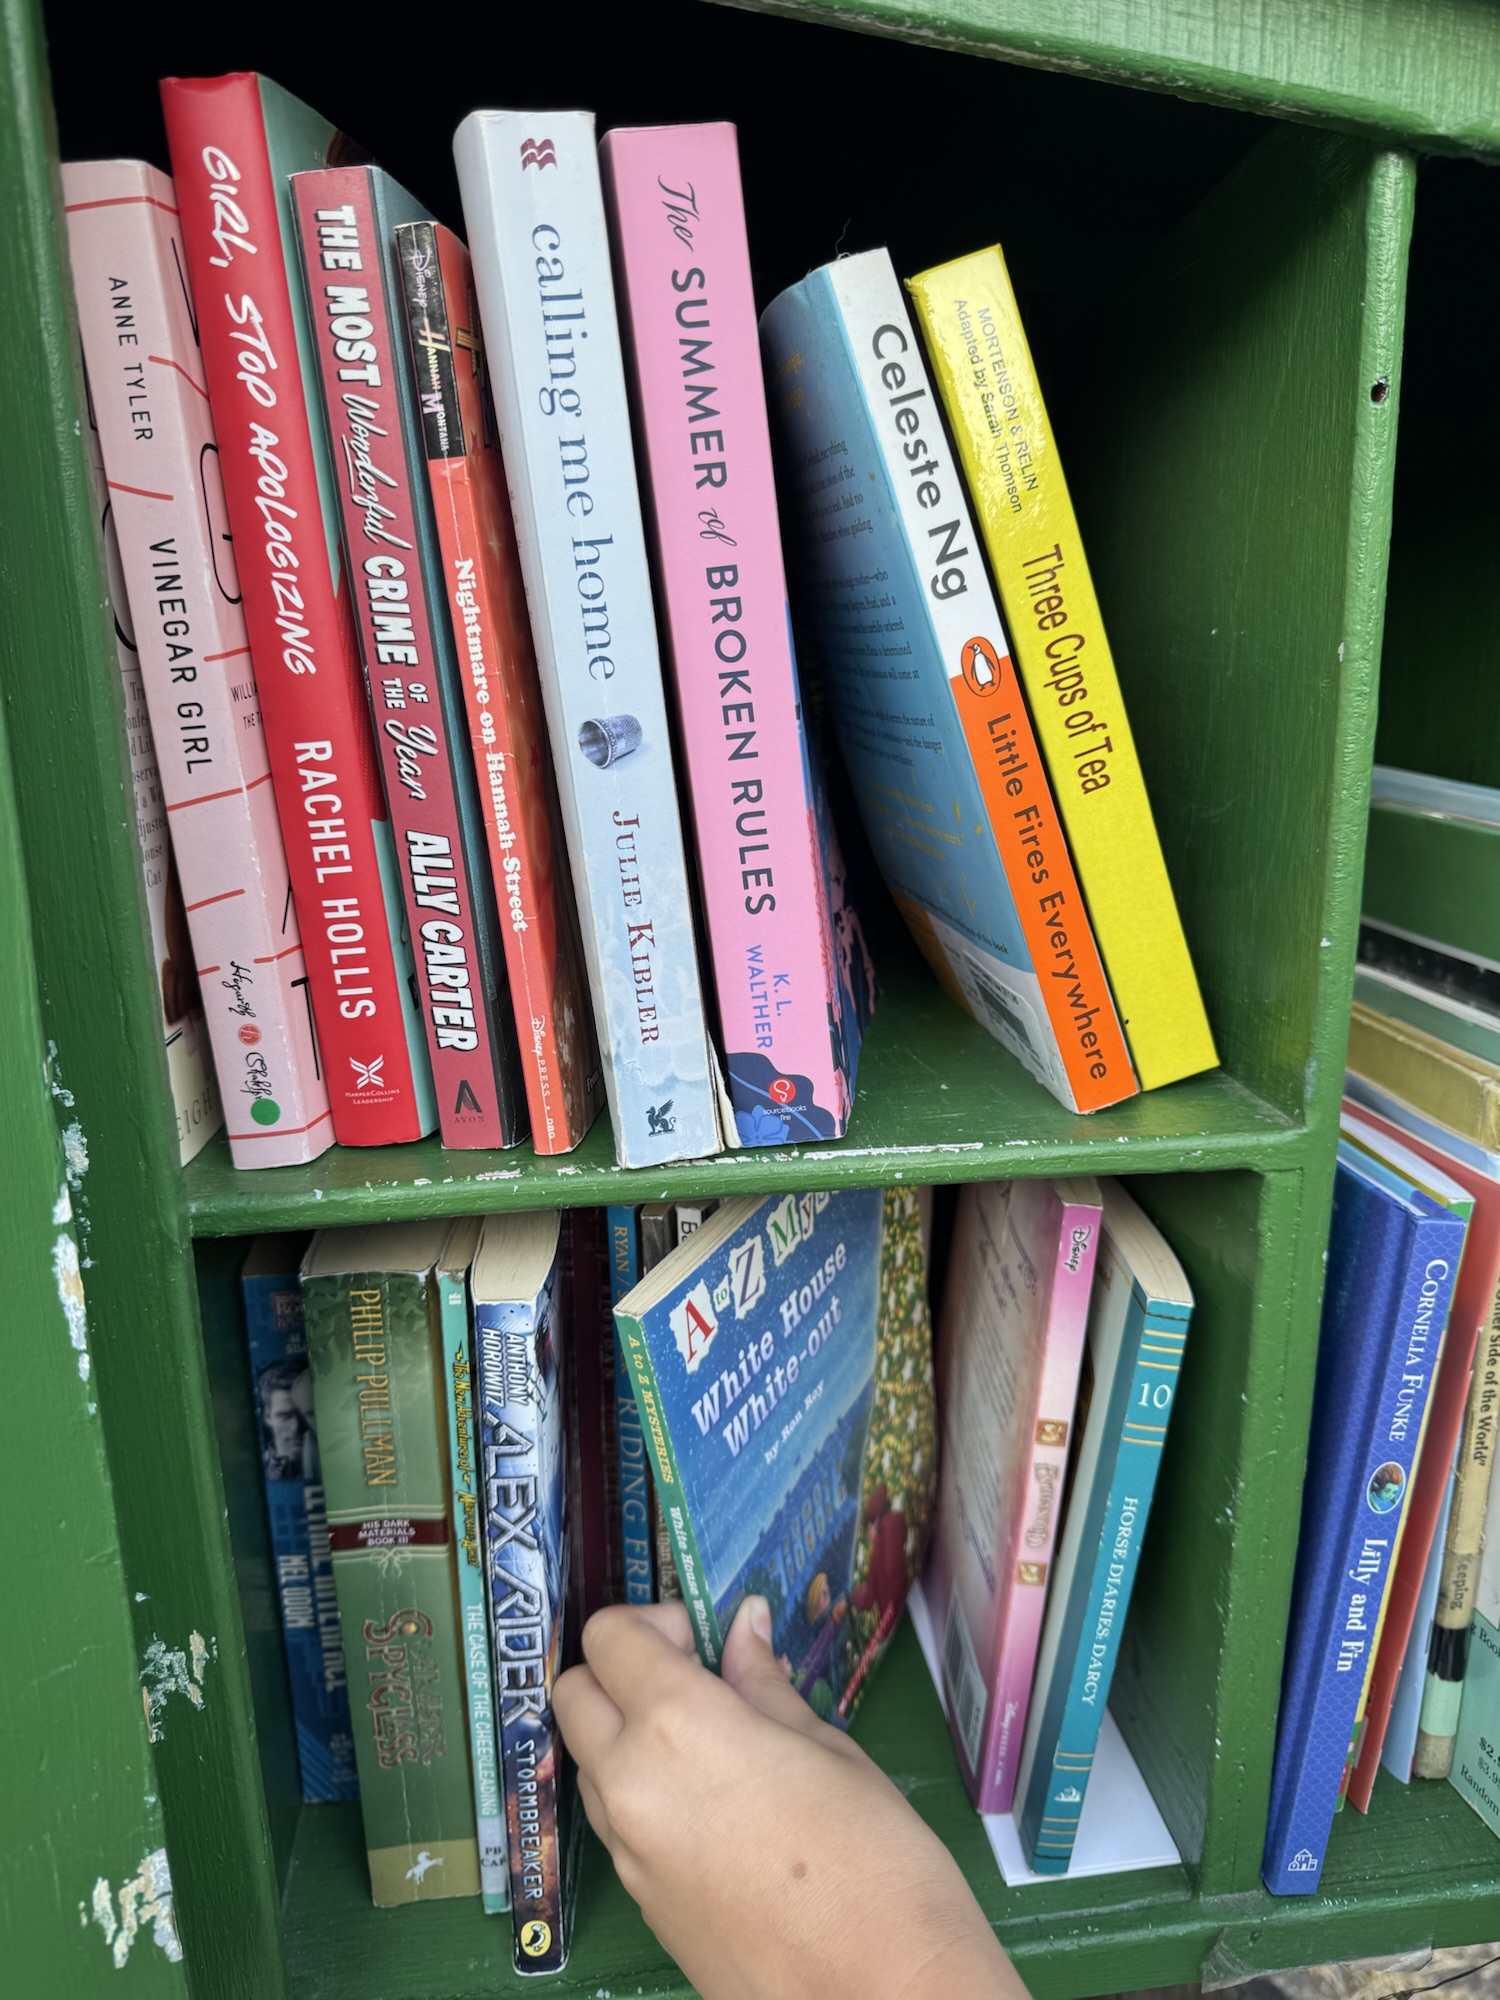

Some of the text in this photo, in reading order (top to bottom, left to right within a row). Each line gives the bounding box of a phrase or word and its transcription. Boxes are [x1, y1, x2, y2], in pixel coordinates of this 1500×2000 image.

[411, 246, 431, 308] Disney
[107, 275, 154, 442] ANNE TYLER
[202, 144, 317, 676] GIRL, STOP APOLOGIZING
[313, 203, 421, 667] THE MOST Wonderful CRIME
[953, 299, 1023, 514] Adapted by Sarah Thomson
[976, 306, 1039, 492] MORTENSON & RELIN
[531, 223, 616, 682] calling me home
[871, 322, 970, 602] Celeste Ng
[657, 173, 776, 916] The SUMMER of BROKEN RULES
[149, 538, 213, 775] VINEGAR GIRL
[381, 676, 408, 709] THE
[407, 680, 430, 704] OF
[1021, 543, 1114, 796] Three Cups of Tea
[382, 717, 440, 802] Year
[454, 558, 528, 933] Nightmare on Hannah Street
[294, 739, 377, 1019] RACHEL HOLLIS
[986, 712, 1108, 1082] Little Fires Everywhere
[404, 828, 479, 1053] ALLY CARTER
[611, 809, 661, 1045] JULIE KIBLER
[745, 943, 774, 1050] WALTHER
[772, 971, 793, 1017] K. L.
[537, 1058, 551, 1097] PRESS
[763, 1104, 807, 1115] sourcebooks
[454, 1114, 485, 1124] AVON
[780, 1113, 792, 1121] fire
[614, 1225, 630, 1274] RYAN
[1064, 1225, 1092, 1274] Disney
[685, 1241, 761, 1364] A to Z
[690, 1241, 848, 1437] White House
[481, 1326, 505, 1408] HOROWITZ
[505, 1330, 530, 1407] ANTHONY
[628, 1334, 642, 1349] A
[632, 1356, 644, 1370] to
[637, 1374, 650, 1385] Z
[722, 1293, 843, 1459] White-out
[1388, 1258, 1449, 1444] CORNELIA FUNKE
[1484, 1369, 1498, 1387] of
[1486, 1334, 1500, 1367] Side
[349, 1287, 398, 1487] PHILIP PULLMAN
[454, 1360, 476, 1477] The New Adventures of
[763, 1379, 825, 1465] by Ron Roy
[1137, 1382, 1173, 1409] 10
[1480, 1387, 1497, 1413] the
[618, 1396, 648, 1526] RIDING
[639, 1389, 675, 1485] MYSTERIES
[357, 1527, 416, 1539] MATERIALS
[361, 1518, 411, 1530] HIS DARK
[366, 1536, 396, 1546] BOOK
[668, 1505, 688, 1550] White
[1111, 1495, 1139, 1562] HORSE
[278, 1554, 314, 1628] MEL ODOM
[484, 1410, 549, 1735] ALEX RIDER
[677, 1552, 699, 1596] House
[1336, 1537, 1388, 1673] Lilly and Fin
[467, 1603, 483, 1630] THE
[468, 1632, 486, 1669] CASE
[471, 1671, 488, 1690] OF
[474, 1692, 490, 1719] THE
[1080, 1641, 1108, 1707] DARCY
[475, 1720, 497, 1817] CHEERLEADING
[1460, 1763, 1500, 1816] Random
[485, 1846, 502, 1855] PB
[515, 1738, 545, 1901] STORMBREAKER
